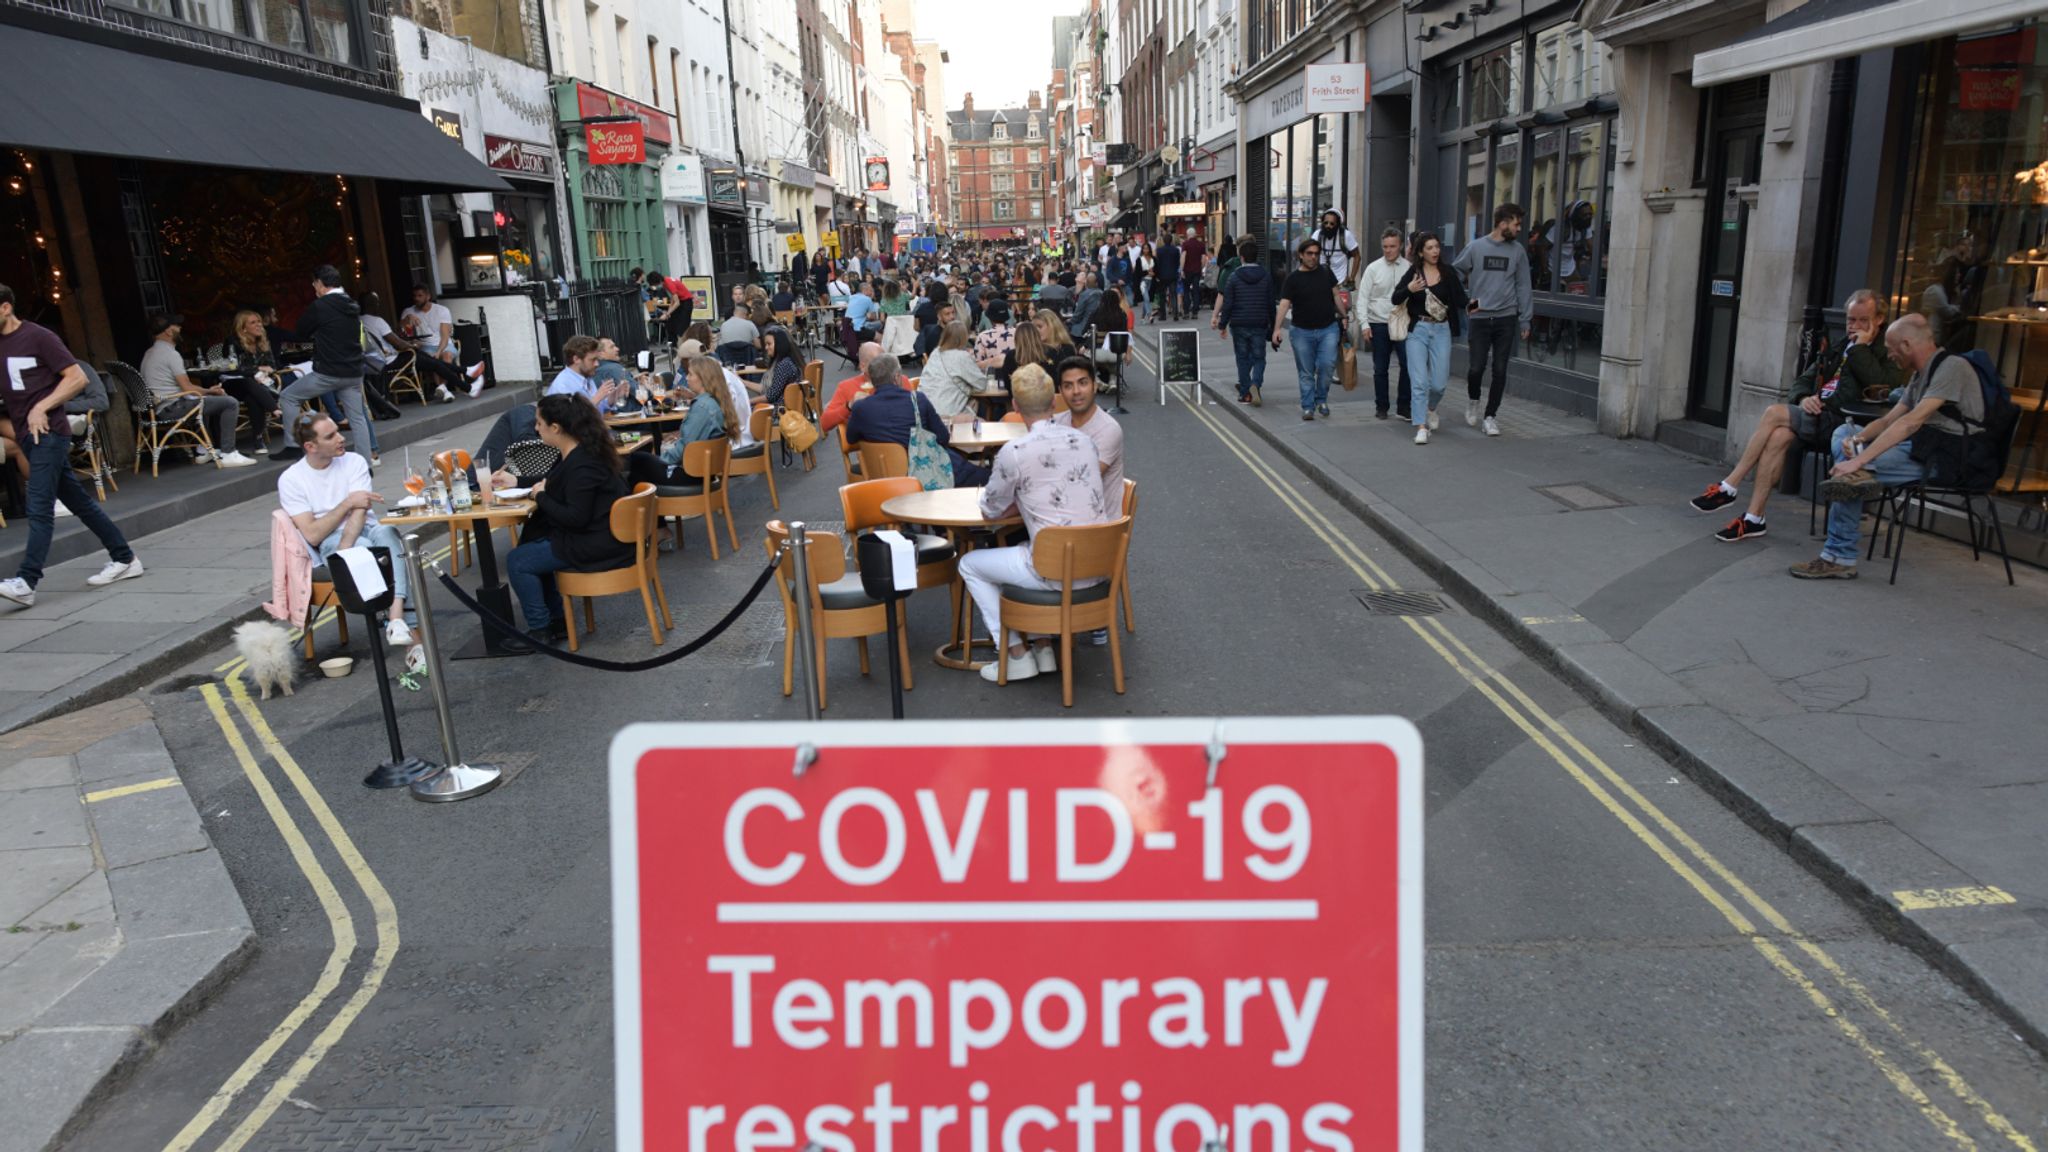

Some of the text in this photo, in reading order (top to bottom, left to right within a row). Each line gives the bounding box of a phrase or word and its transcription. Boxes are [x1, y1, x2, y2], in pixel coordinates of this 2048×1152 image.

[1312, 86, 1360, 96] Frith Street
[597, 142, 637, 161] Sayang
[605, 131, 634, 145] Rasa
[724, 785, 1311, 885] COVID-19
[708, 956, 1327, 1067] Temporary
[689, 1081, 1353, 1152] restrictions
